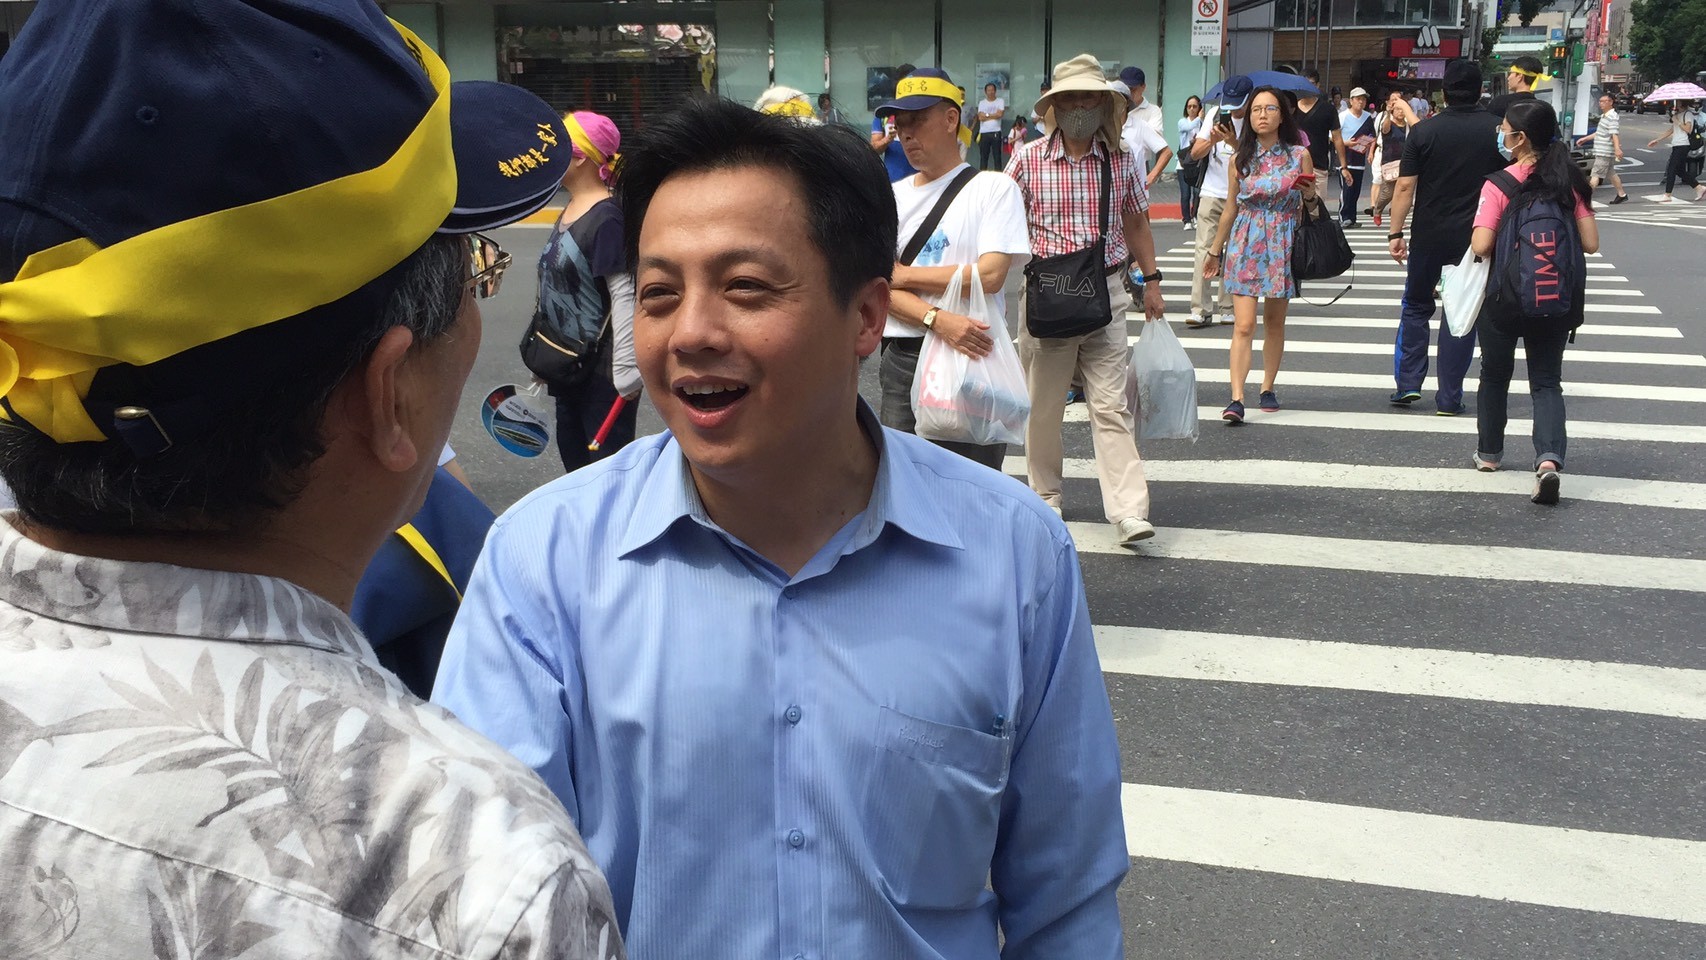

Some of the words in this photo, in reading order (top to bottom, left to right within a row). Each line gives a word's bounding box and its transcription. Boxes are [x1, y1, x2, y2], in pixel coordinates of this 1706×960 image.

[1554, 47, 1566, 58] 11
[1531, 230, 1559, 307] TIME
[1039, 272, 1096, 298] FILA
